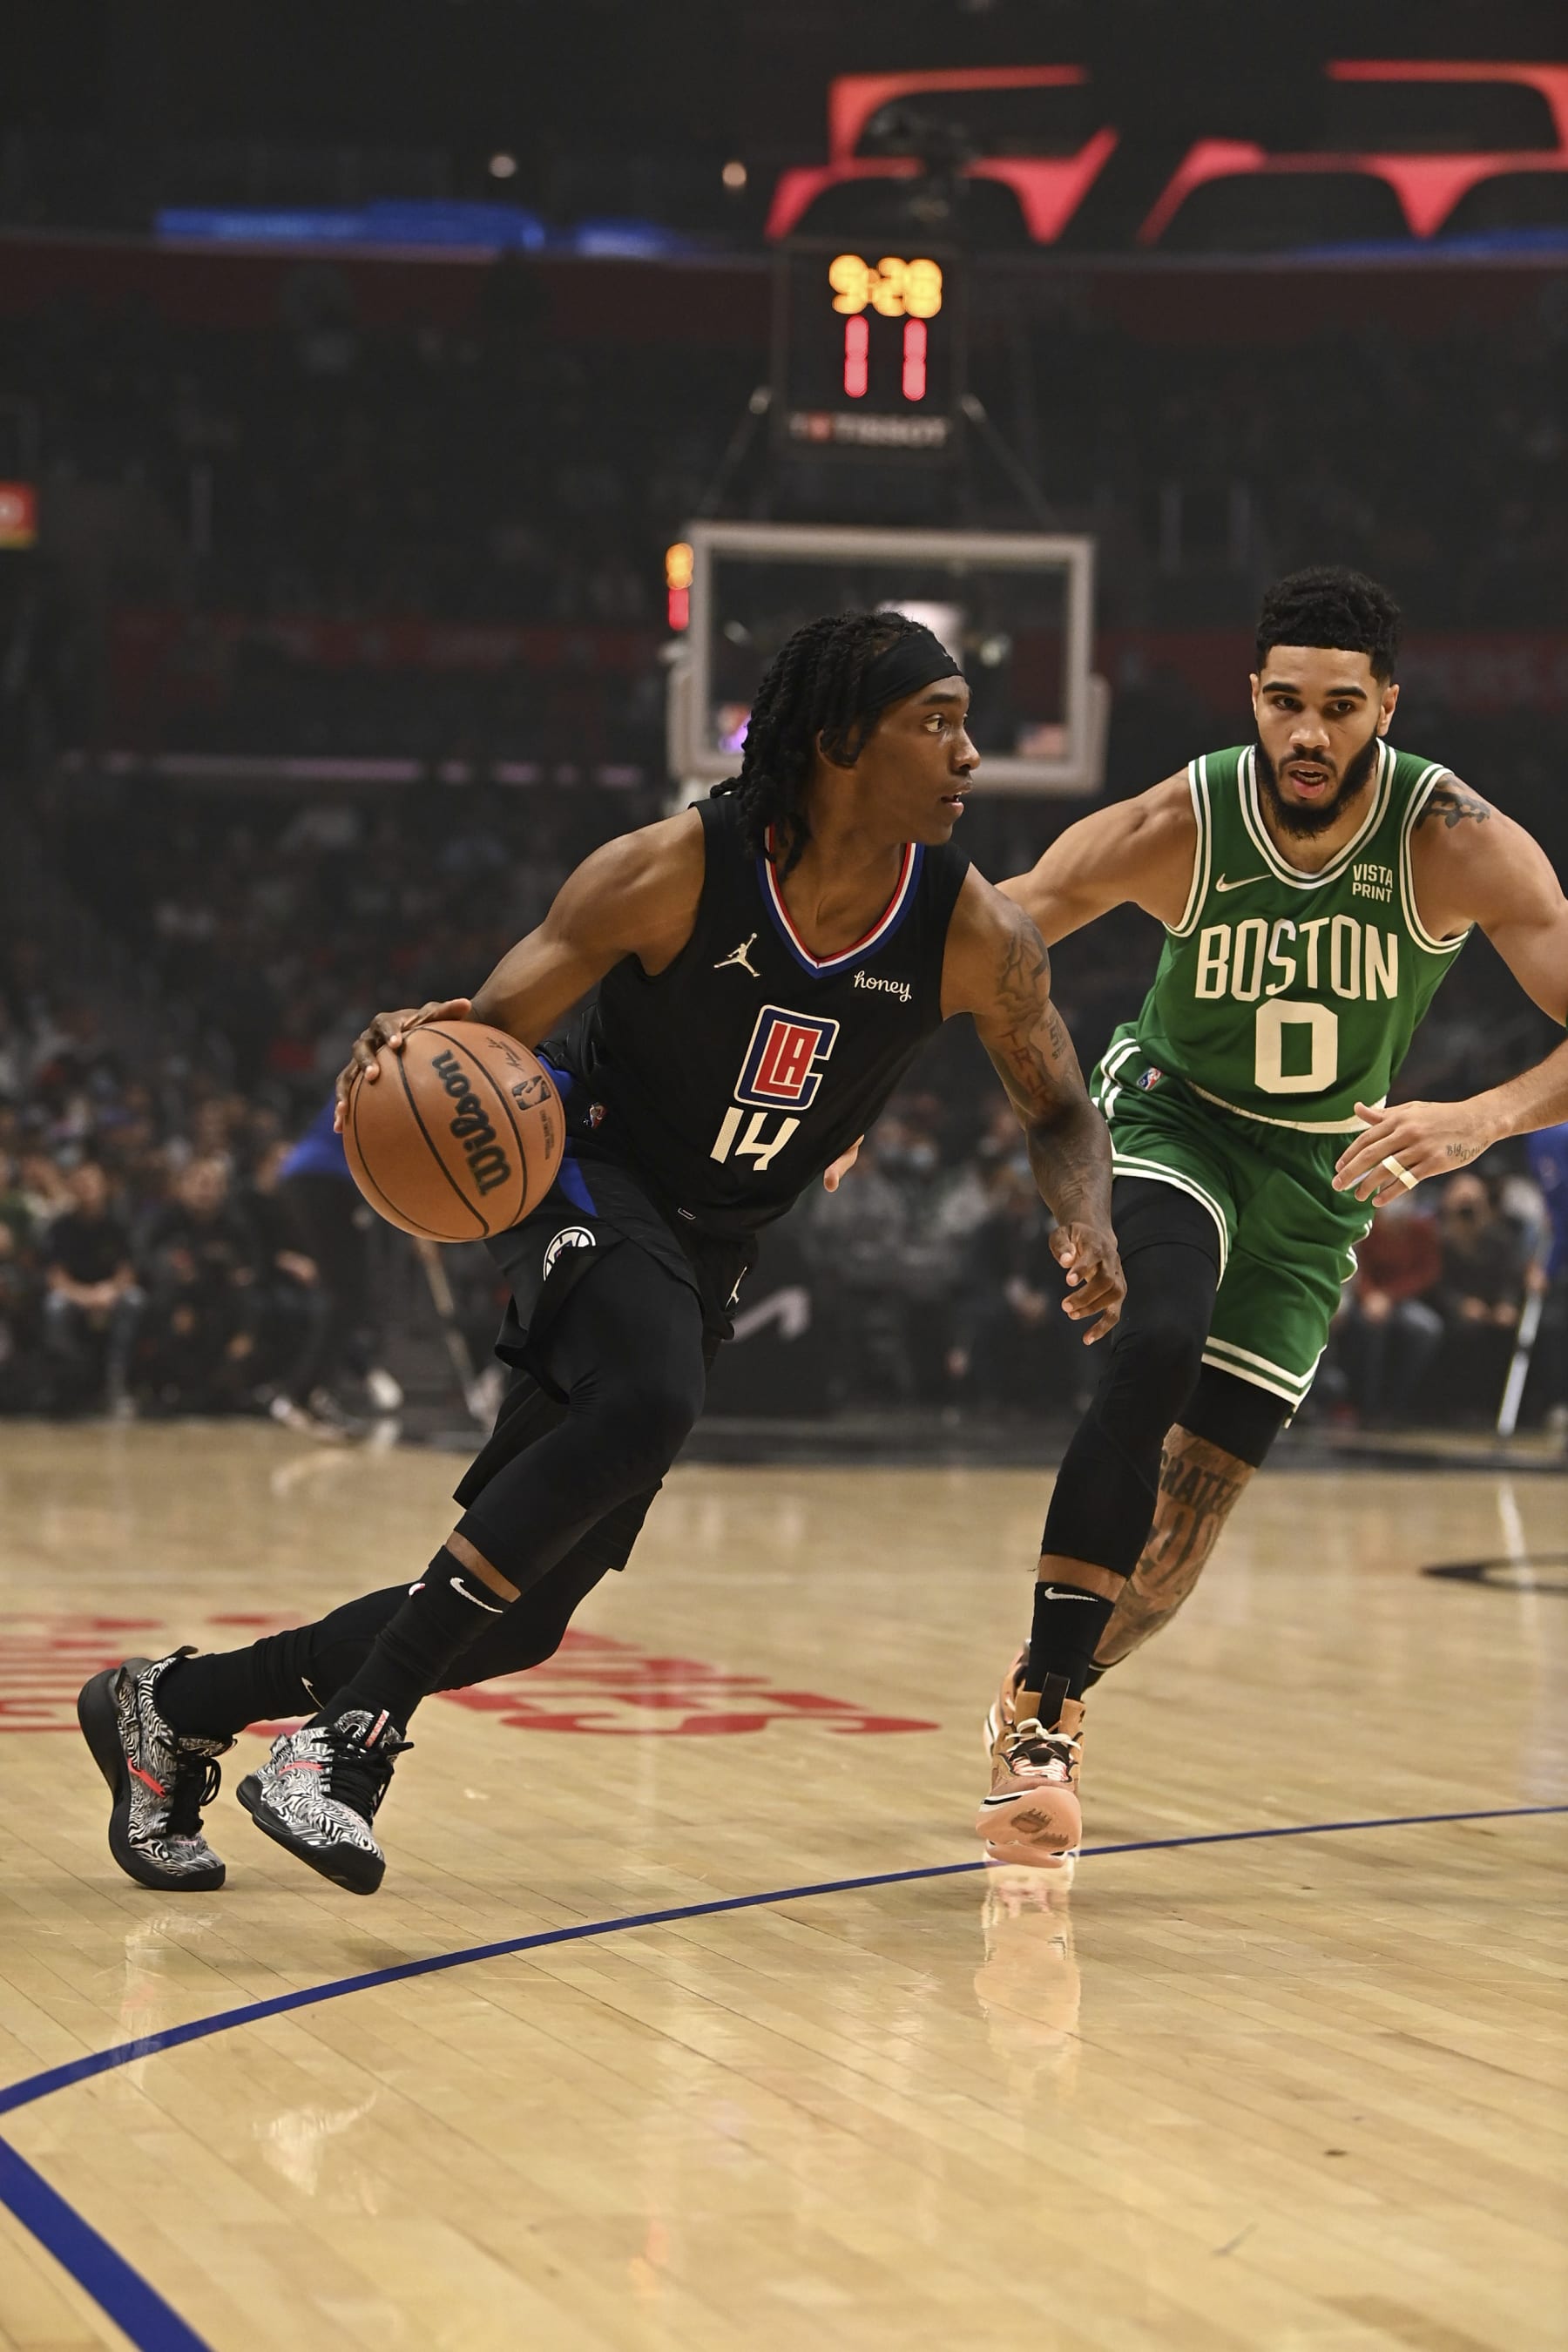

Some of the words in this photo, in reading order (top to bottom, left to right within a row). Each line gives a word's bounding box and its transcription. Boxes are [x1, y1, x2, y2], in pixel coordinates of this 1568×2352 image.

[829, 254, 943, 319] 9:28
[844, 314, 928, 402] 11
[1352, 863, 1394, 889] VISTA
[1352, 882, 1393, 903] PRINT
[854, 970, 912, 1003] honey
[1194, 914, 1398, 1002] BOSTON
[1254, 998, 1338, 1094] 0
[431, 1049, 511, 1198] Wilson
[710, 1106, 801, 1171] 14
